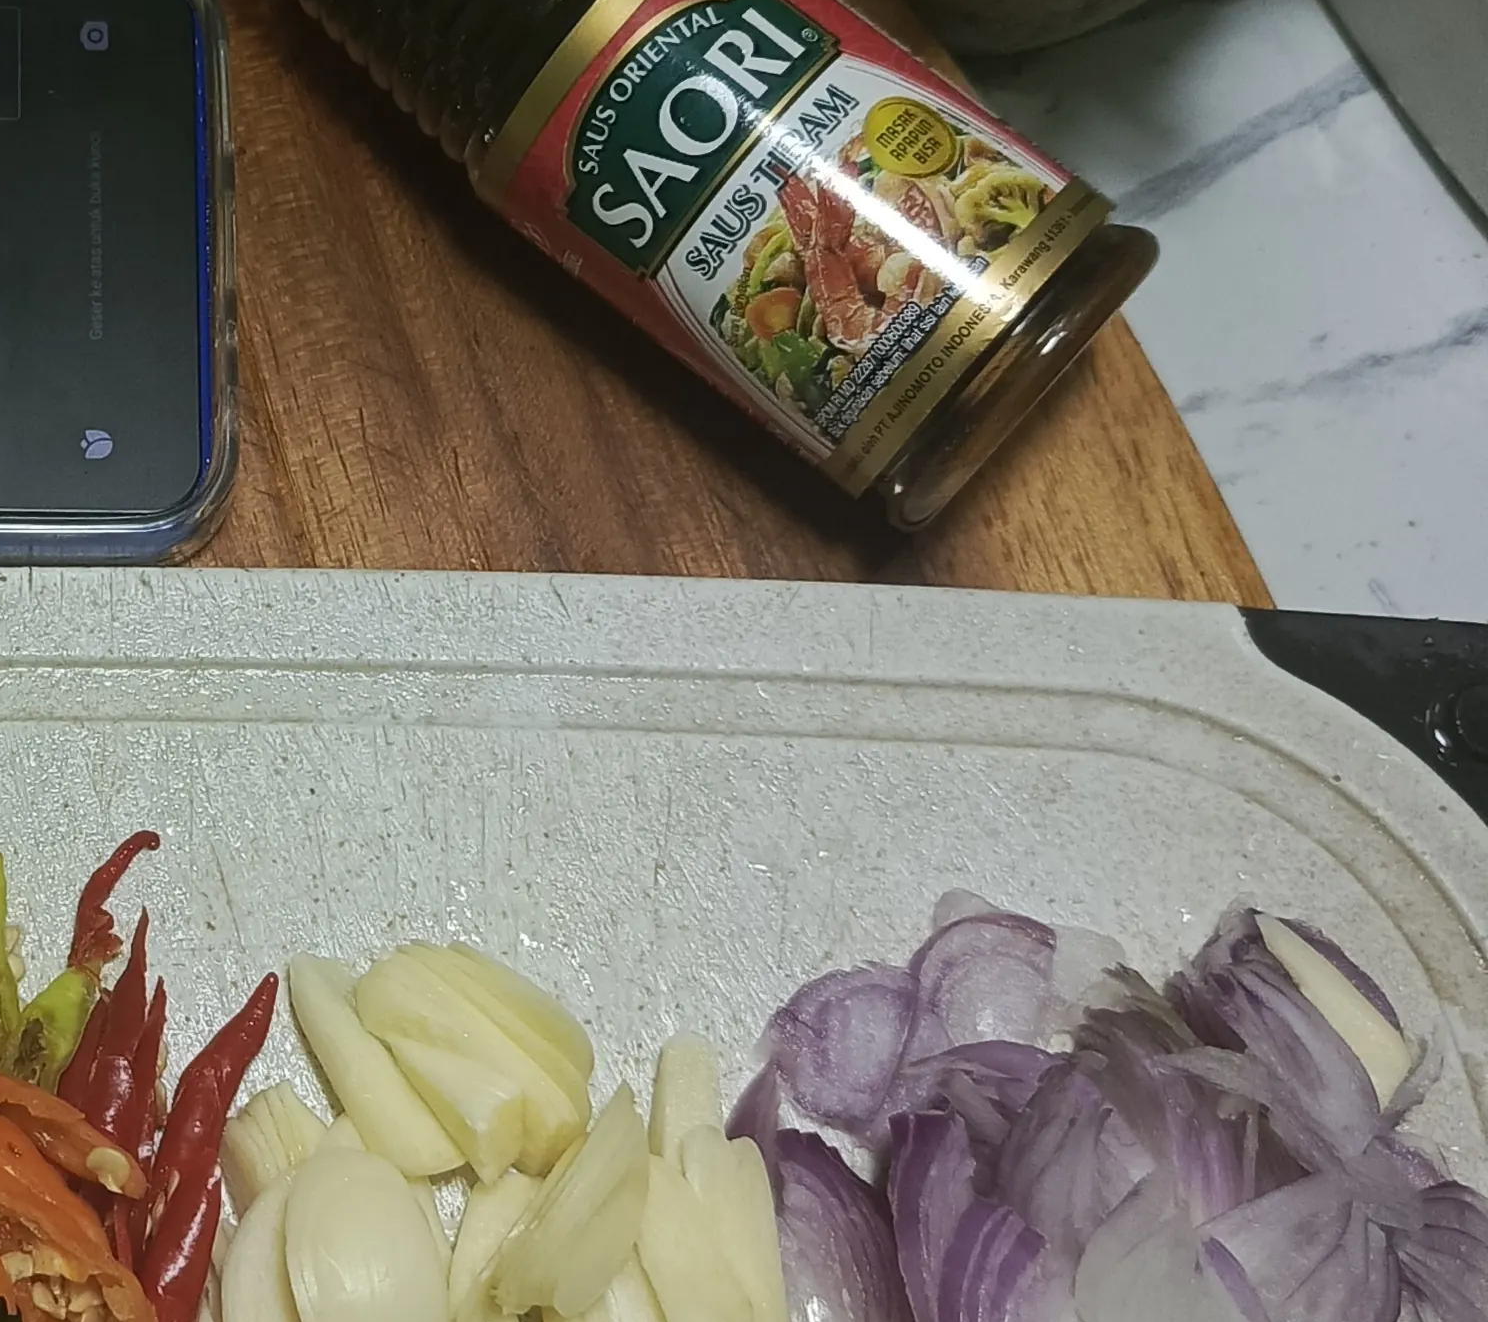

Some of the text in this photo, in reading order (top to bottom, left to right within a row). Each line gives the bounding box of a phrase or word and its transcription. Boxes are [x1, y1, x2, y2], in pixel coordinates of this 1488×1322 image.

[576, 6, 724, 174] SAUS ORIENTAL
[596, 6, 805, 249] SAORI
[875, 107, 916, 148] MASAK
[889, 118, 934, 161] APAPUN
[912, 137, 943, 164] BISA
[88, 171, 102, 204] buka
[682, 84, 858, 280] SAUS TIRAM
[88, 207, 102, 245] untuk
[90, 247, 102, 277] atas
[88, 279, 103, 297] ke
[919, 311, 938, 331] sisi
[931, 293, 952, 315] lain
[873, 418, 890, 437] PT
[886, 356, 945, 420] AJINOMOTO
[999, 241, 1051, 290] Karawang
